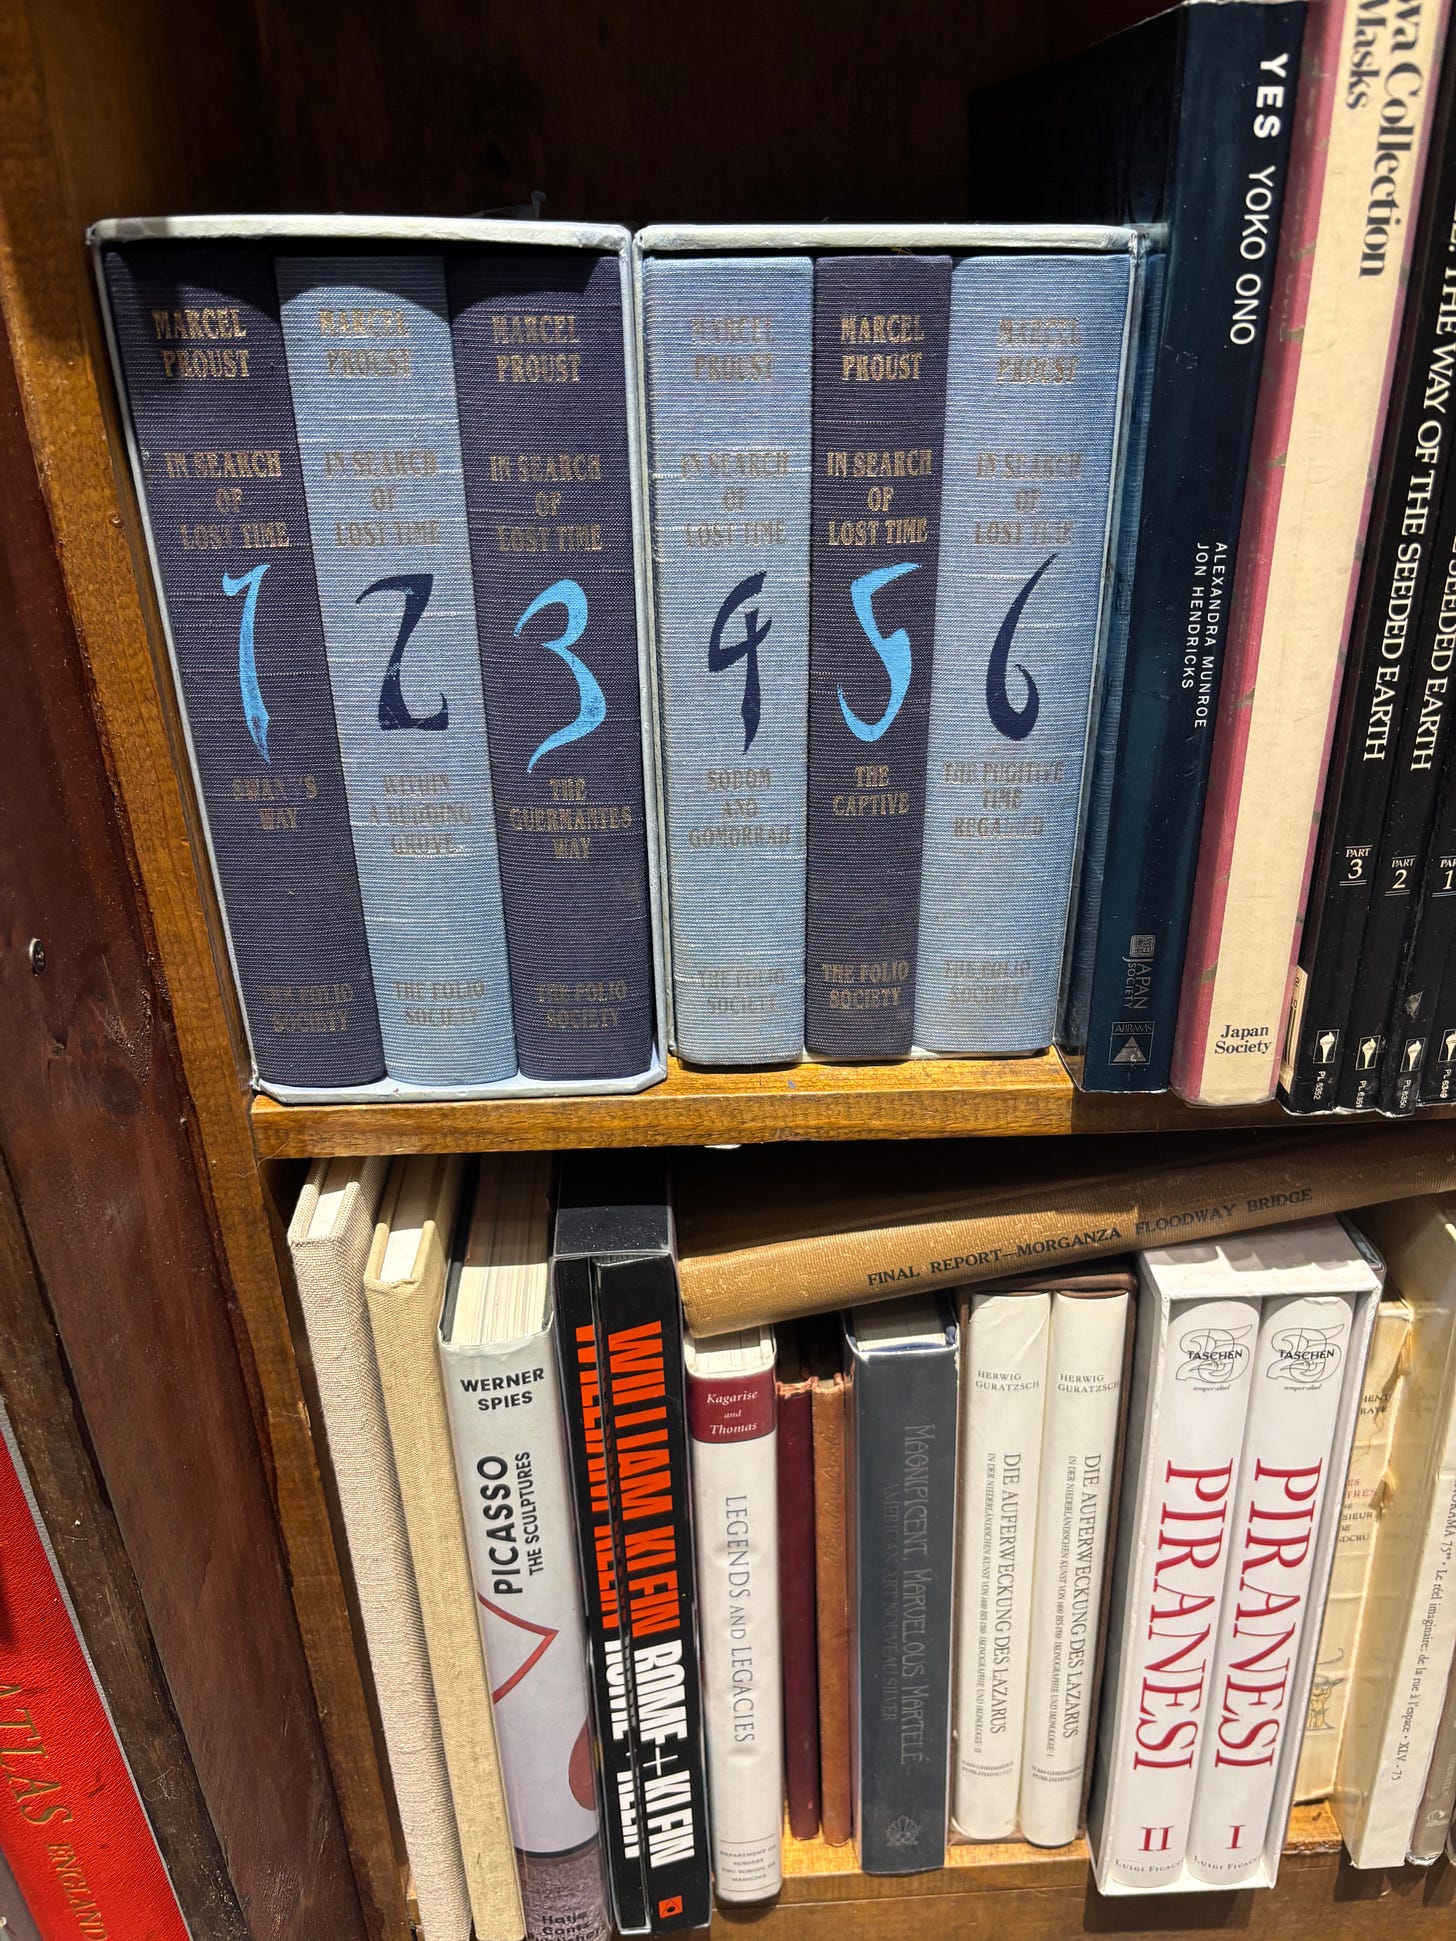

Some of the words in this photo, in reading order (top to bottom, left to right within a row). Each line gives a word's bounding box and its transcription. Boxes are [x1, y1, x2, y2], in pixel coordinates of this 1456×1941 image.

[1253, 52, 1290, 139] YES
[1359, 60, 1424, 280] Collection
[1239, 165, 1276, 261] YOKO
[153, 308, 247, 339] MARCEL
[1229, 273, 1262, 346] ONO
[840, 314, 925, 343] MARCEL
[163, 349, 250, 378] PROUST
[842, 354, 922, 381] PROUST
[1423, 344, 1456, 415] WAY
[1415, 420, 1442, 465] OF
[164, 453, 191, 478] IN
[194, 451, 282, 478] SEARCH
[827, 451, 848, 477] IN
[853, 449, 932, 476] SEARCH
[215, 488, 243, 513] OF
[867, 487, 894, 512] OF
[1401, 470, 1437, 537] THE
[181, 525, 235, 550] LOST
[242, 522, 290, 548] TIME
[828, 521, 878, 546] LOST
[884, 519, 928, 543] TIME
[1193, 542, 1209, 576] JON
[1204, 542, 1228, 647] ALEXANDRA
[1380, 542, 1421, 661] SEEDED
[356, 573, 449, 731] 2
[836, 562, 922, 742] 5
[986, 553, 1057, 741] 6
[1181, 586, 1204, 690] HENDRICKS
[223, 564, 271, 764] 1
[513, 579, 607, 773] 3
[708, 572, 772, 755] 4
[1194, 656, 1215, 729] MUNROE
[1363, 665, 1400, 762] EARTH
[1410, 676, 1449, 771] EARTH
[854, 765, 889, 788] THE
[832, 794, 909, 817] CAPTIVE
[553, 837, 591, 859] WAY
[1345, 848, 1371, 858] PART
[1391, 858, 1416, 868] PART
[1347, 859, 1363, 880] 3
[1392, 869, 1407, 889] 2
[1442, 869, 1454, 890] 1
[859, 960, 909, 982] FOLIO
[1121, 956, 1154, 1009] JAPAN
[1123, 962, 1137, 1009] SOCIETY
[829, 987, 901, 1009] SOCIETY
[1114, 1023, 1152, 1033] ABRAMS
[1219, 1024, 1270, 1040] Japan
[1214, 1039, 1273, 1056] Society
[866, 1263, 921, 1288] FINAL
[1134, 1202, 1236, 1238] FLOODWAY
[1246, 1188, 1313, 1214] BRIDGE
[1187, 1348, 1243, 1361] TASCHEN
[1278, 1348, 1335, 1360] TASCHEN
[460, 1367, 545, 1393] WERNER
[975, 1379, 1039, 1392] GURATZSCH
[977, 1369, 1022, 1381] HERWIG
[1057, 1381, 1119, 1394] GURATZSCH
[1060, 1373, 1104, 1383] HERWIG
[477, 1391, 533, 1411] SPIES
[706, 1389, 758, 1405] Kagarise
[607, 1320, 673, 1521] WILLIAM
[709, 1421, 758, 1436] Thomas
[723, 1408, 742, 1419] and
[1002, 1452, 1021, 1485] DIE
[1082, 1452, 1101, 1487] DIE
[514, 1451, 540, 1545] SCULPTURES
[476, 1455, 523, 1596] PICASSO
[725, 1493, 750, 1600] LEGENDS
[995, 1489, 1019, 1633] AUFERWECKUNG
[529, 1547, 544, 1577] THE
[1070, 1491, 1098, 1635] AUFERWECKUNG
[1435, 1569, 1447, 1581] Le
[624, 1525, 680, 1638] KLEIN
[730, 1604, 746, 1641] AND
[902, 1568, 932, 1678] MARVELOUS
[1133, 1457, 1233, 1771] PIRANESI
[1214, 1457, 1323, 1768] PIRANESI
[993, 1636, 1011, 1665] DES
[1067, 1639, 1086, 1669] DES
[1417, 1654, 1429, 1665] de
[1411, 1677, 1421, 1693] rue
[1415, 1667, 1427, 1676] la
[634, 1639, 688, 1745] ROME
[730, 1646, 756, 1743] LEGACIES
[881, 1678, 896, 1722] SILVER
[989, 1669, 1009, 1735] LAZARUS
[1063, 1672, 1083, 1739] LAZARUS
[642, 1747, 679, 1776] +
[1398, 1741, 1411, 1763] XLV
[644, 1770, 695, 1868] KLEIN
[1137, 1825, 1175, 1852] II
[1225, 1824, 1246, 1850] I
[46, 1843, 109, 1941] ENGLAND
